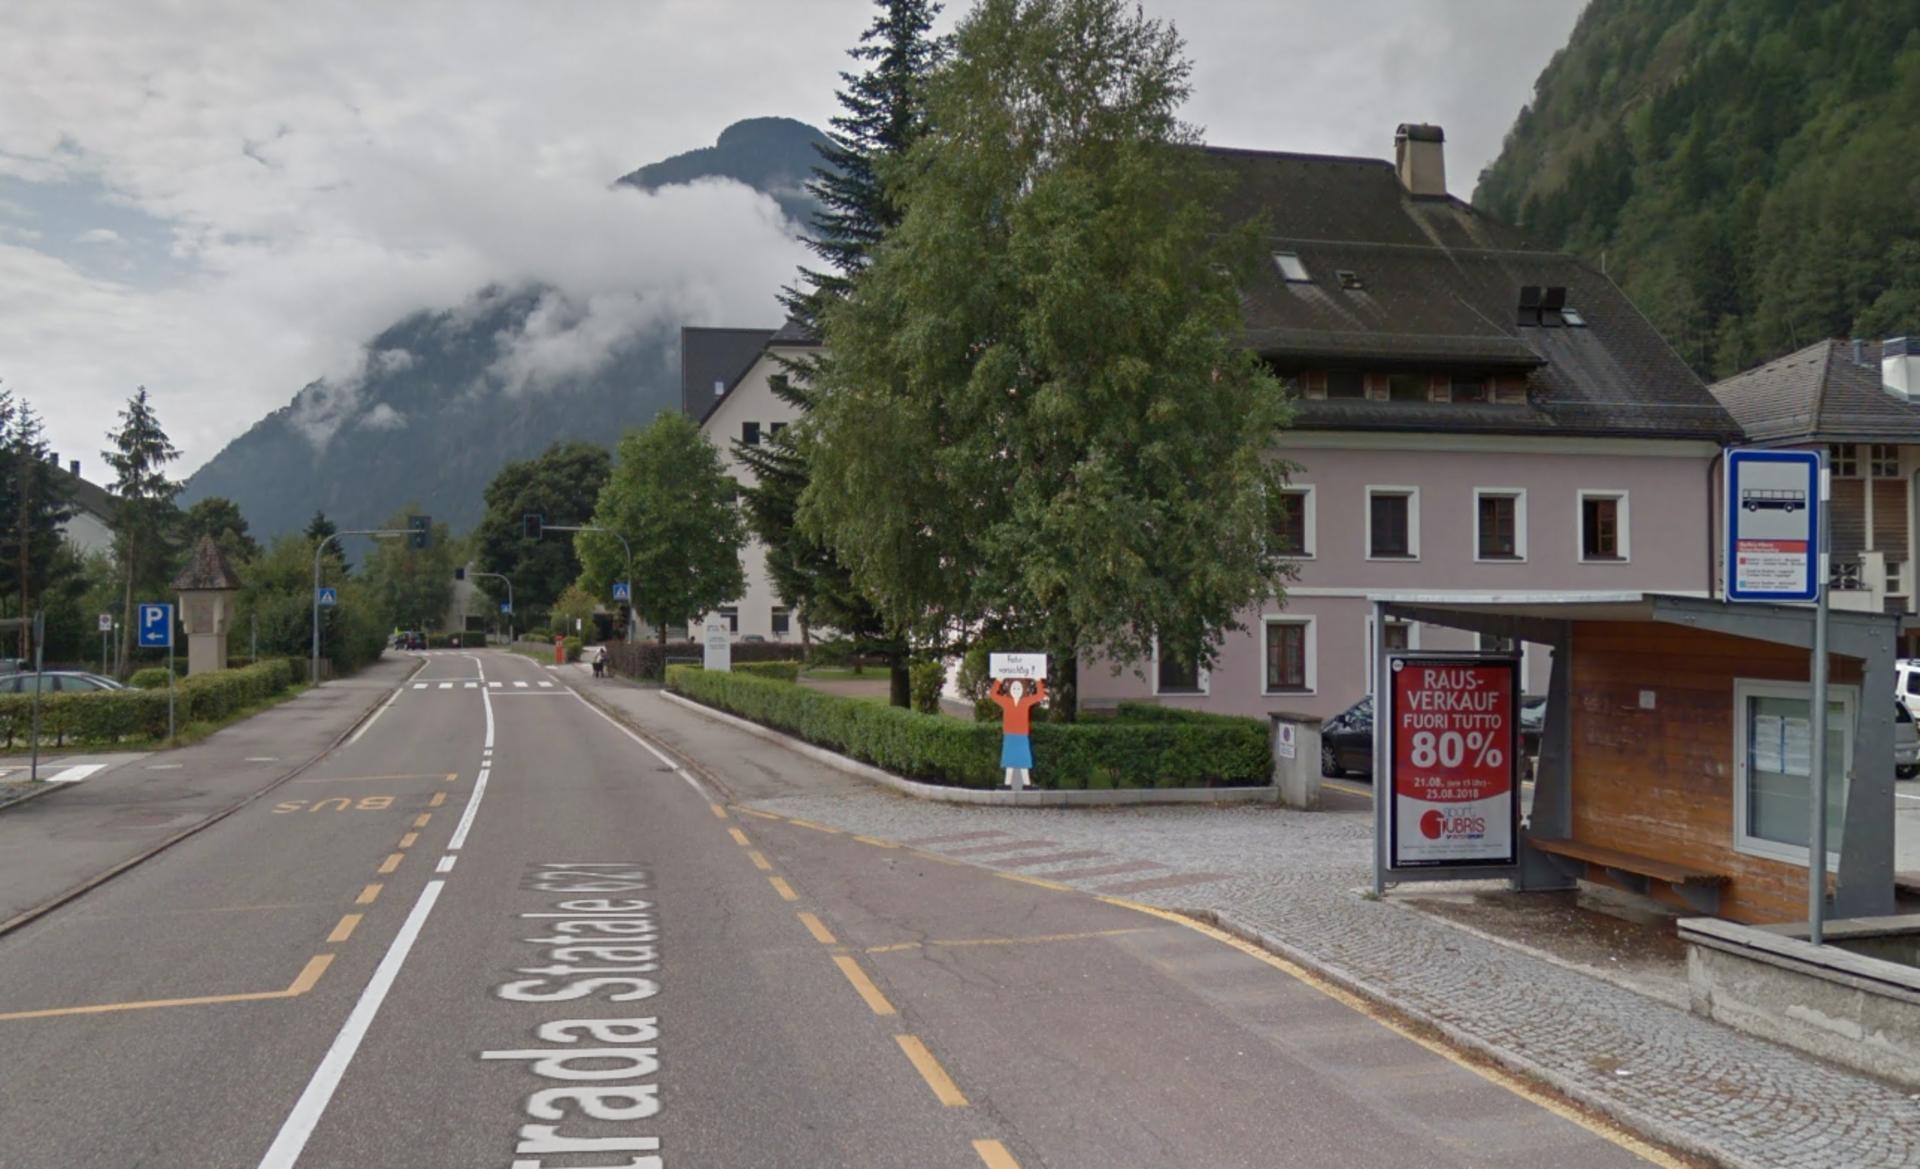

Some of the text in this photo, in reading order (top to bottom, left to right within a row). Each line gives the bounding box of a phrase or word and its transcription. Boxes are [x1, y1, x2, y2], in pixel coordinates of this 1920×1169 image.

[146, 607, 163, 628] P
[1423, 669, 1484, 690] RAUS-
[1407, 690, 1499, 712] VERKAUF
[1403, 713, 1502, 729] FUORI TUTTO
[1411, 731, 1503, 768] 80%
[271, 796, 397, 814] BUS
[1435, 817, 1485, 835] TUBRIS
